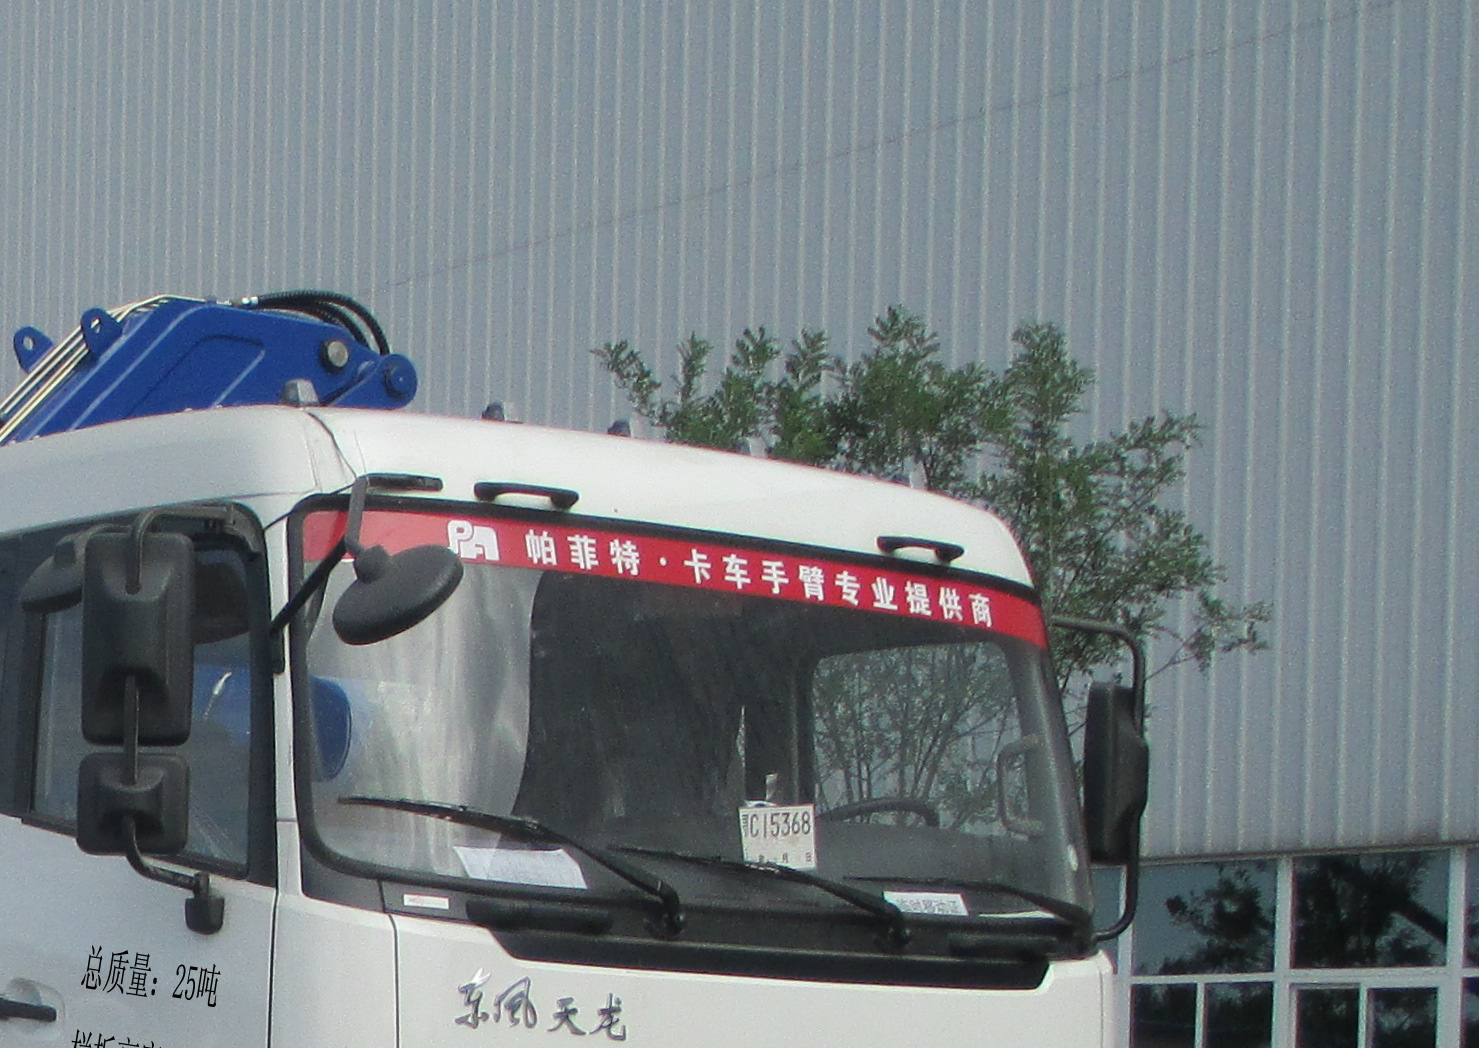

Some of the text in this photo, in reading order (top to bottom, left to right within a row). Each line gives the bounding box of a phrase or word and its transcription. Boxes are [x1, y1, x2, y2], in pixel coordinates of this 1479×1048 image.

[525, 529, 993, 628] 帕菲特·卡车手臂专业提供商
